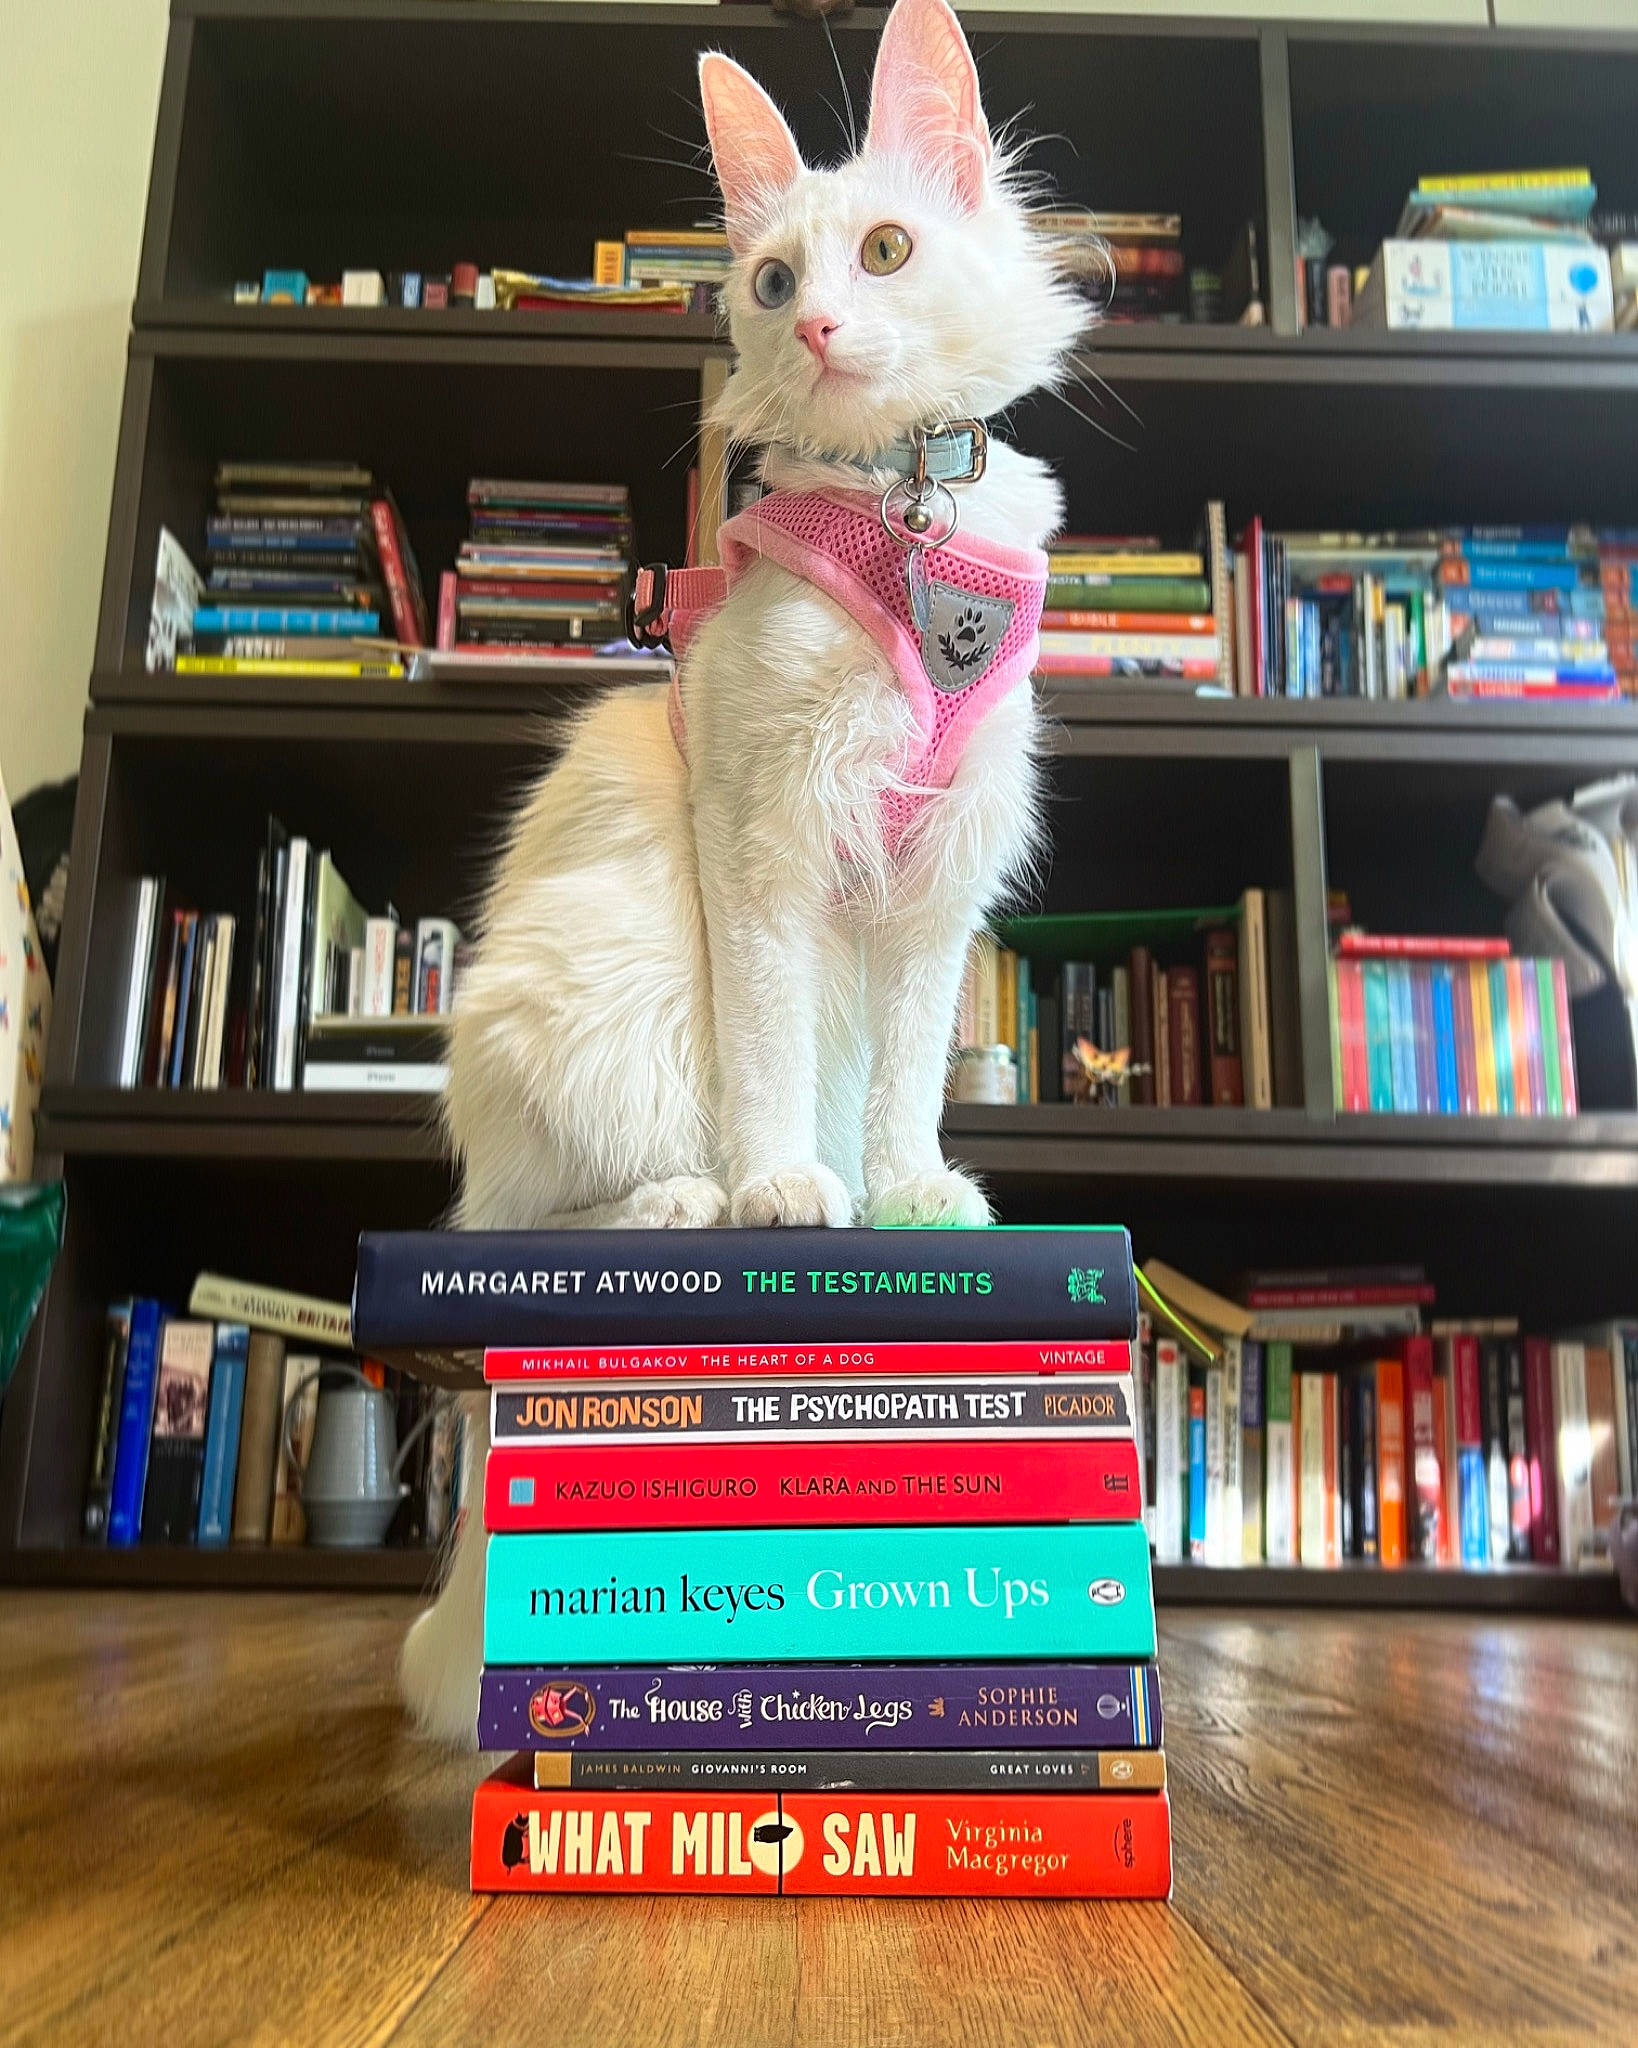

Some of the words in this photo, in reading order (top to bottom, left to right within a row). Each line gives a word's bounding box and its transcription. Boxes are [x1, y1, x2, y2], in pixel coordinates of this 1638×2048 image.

[421, 1270, 586, 1296] MARGARET
[595, 1270, 723, 1295] ATWOOD
[742, 1271, 796, 1295] THE
[806, 1270, 994, 1295] TESTAMENTS
[522, 1358, 590, 1371] MIKHAIL
[598, 1356, 688, 1370] BULGAKOV
[701, 1355, 730, 1367] THE
[738, 1354, 788, 1366] HEART
[795, 1354, 816, 1366] OF
[823, 1354, 833, 1365] A
[839, 1353, 875, 1365] DOG
[1039, 1349, 1106, 1365] VINTAGE
[516, 1395, 576, 1430] JON
[582, 1394, 703, 1429] RONSON
[731, 1396, 780, 1422] THE
[789, 1392, 959, 1423] PSYCHOPATH
[963, 1390, 1027, 1419] TEST
[1043, 1394, 1116, 1418] PICADOR
[555, 1480, 637, 1500] KAZUO
[643, 1477, 758, 1499] ISHIGURO
[780, 1477, 850, 1497] KLARA
[855, 1479, 898, 1496] AND
[901, 1475, 949, 1496] THE
[953, 1474, 1002, 1495] SUN
[529, 1575, 666, 1617] marian
[681, 1573, 786, 1624] keyes
[806, 1569, 951, 1611] Grown
[964, 1567, 1050, 1619] Ups
[978, 1686, 1058, 1706] SOPHIE
[609, 1698, 640, 1719] The
[760, 1689, 852, 1722] Chicken
[852, 1694, 913, 1737] Legs
[958, 1707, 1079, 1727] ANDERSON
[580, 1763, 617, 1775] JAMES
[623, 1763, 681, 1775] BALDWIN
[770, 1763, 808, 1775] ROOM
[989, 1763, 1030, 1776] GREAT
[1035, 1763, 1074, 1776] LOVES
[528, 1810, 652, 1876] WHAT
[822, 1811, 916, 1877] SAW
[946, 1818, 1044, 1845] Virginia
[1121, 1818, 1136, 1868] sphere
[946, 1843, 1070, 1874] Macgregor
